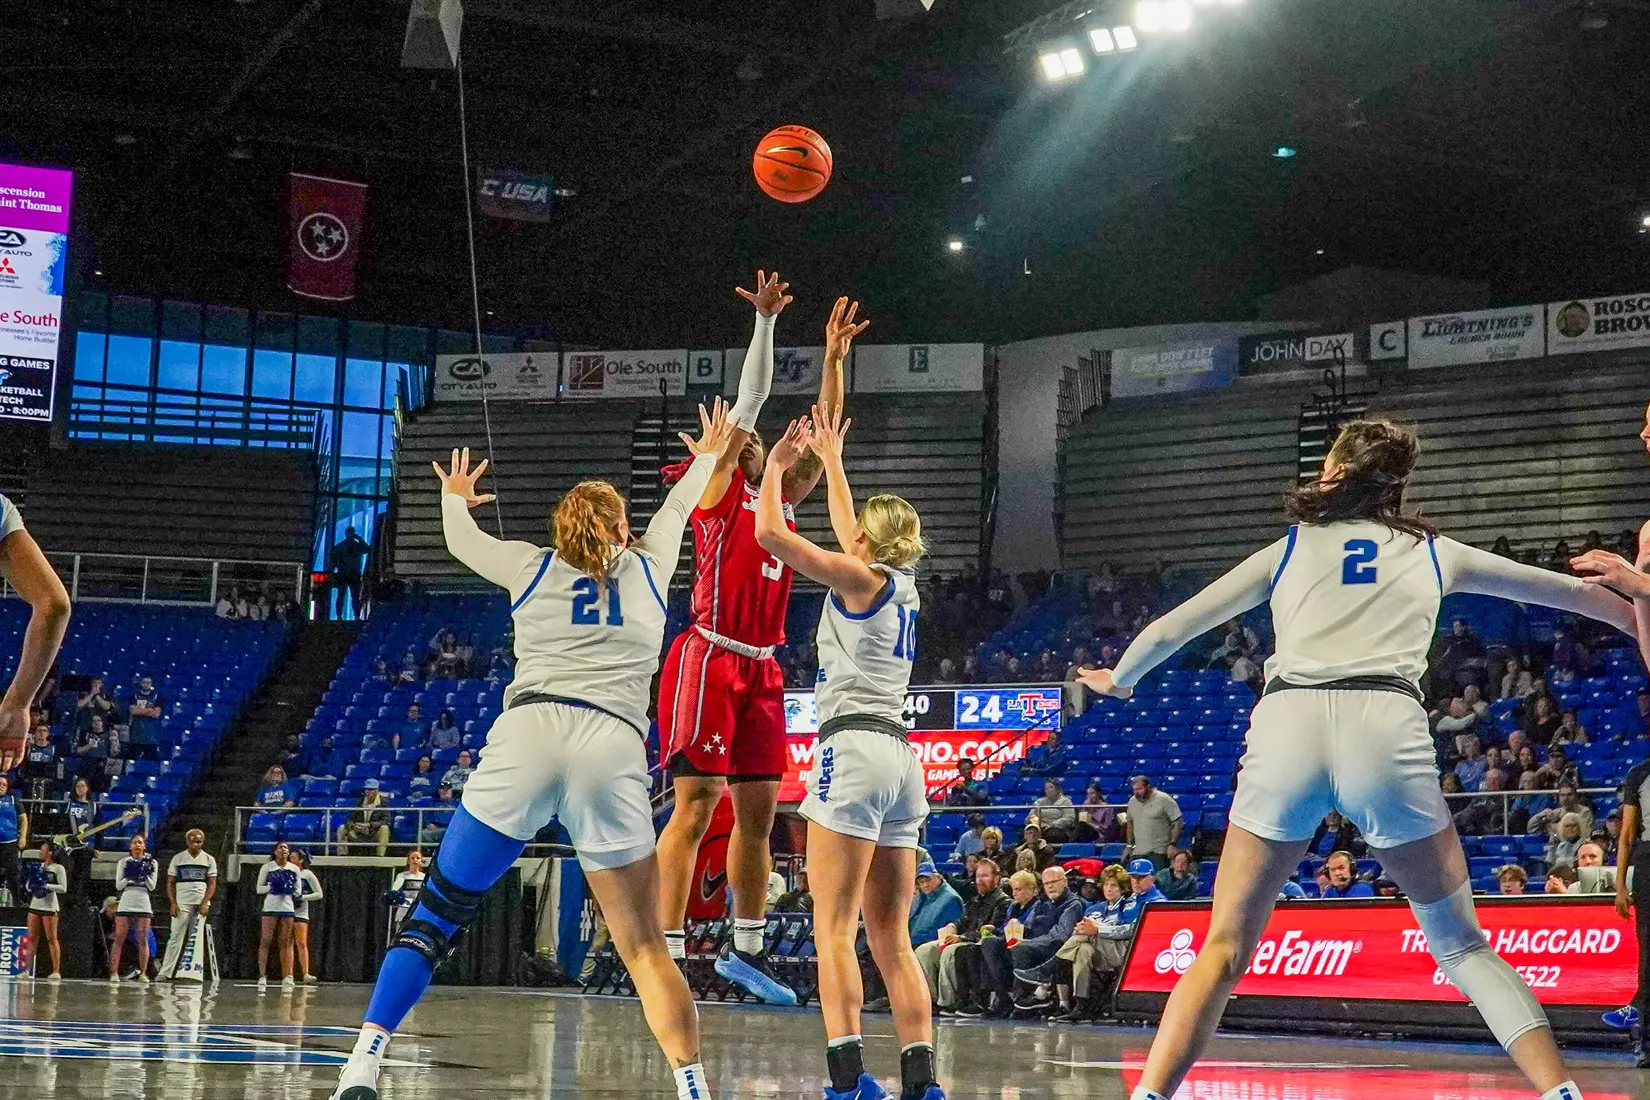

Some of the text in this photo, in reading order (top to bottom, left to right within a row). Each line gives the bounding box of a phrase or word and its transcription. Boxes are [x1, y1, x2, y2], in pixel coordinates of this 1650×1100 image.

[0, 187, 46, 199] scension
[0, 197, 63, 213] int Thomas
[13, 310, 58, 328] South
[1251, 337, 1347, 362] JOHN DAY
[1379, 329, 1397, 351] C
[10, 358, 50, 370] GAMES
[605, 358, 683, 375] Ole South
[697, 357, 713, 378] B
[12, 406, 49, 417] 8:00PM
[1342, 538, 1378, 585] 2
[571, 576, 624, 626] 21
[959, 694, 1004, 724] 24
[0, 928, 13, 975] FROSTY!
[1494, 928, 1622, 954] HAGGARD
